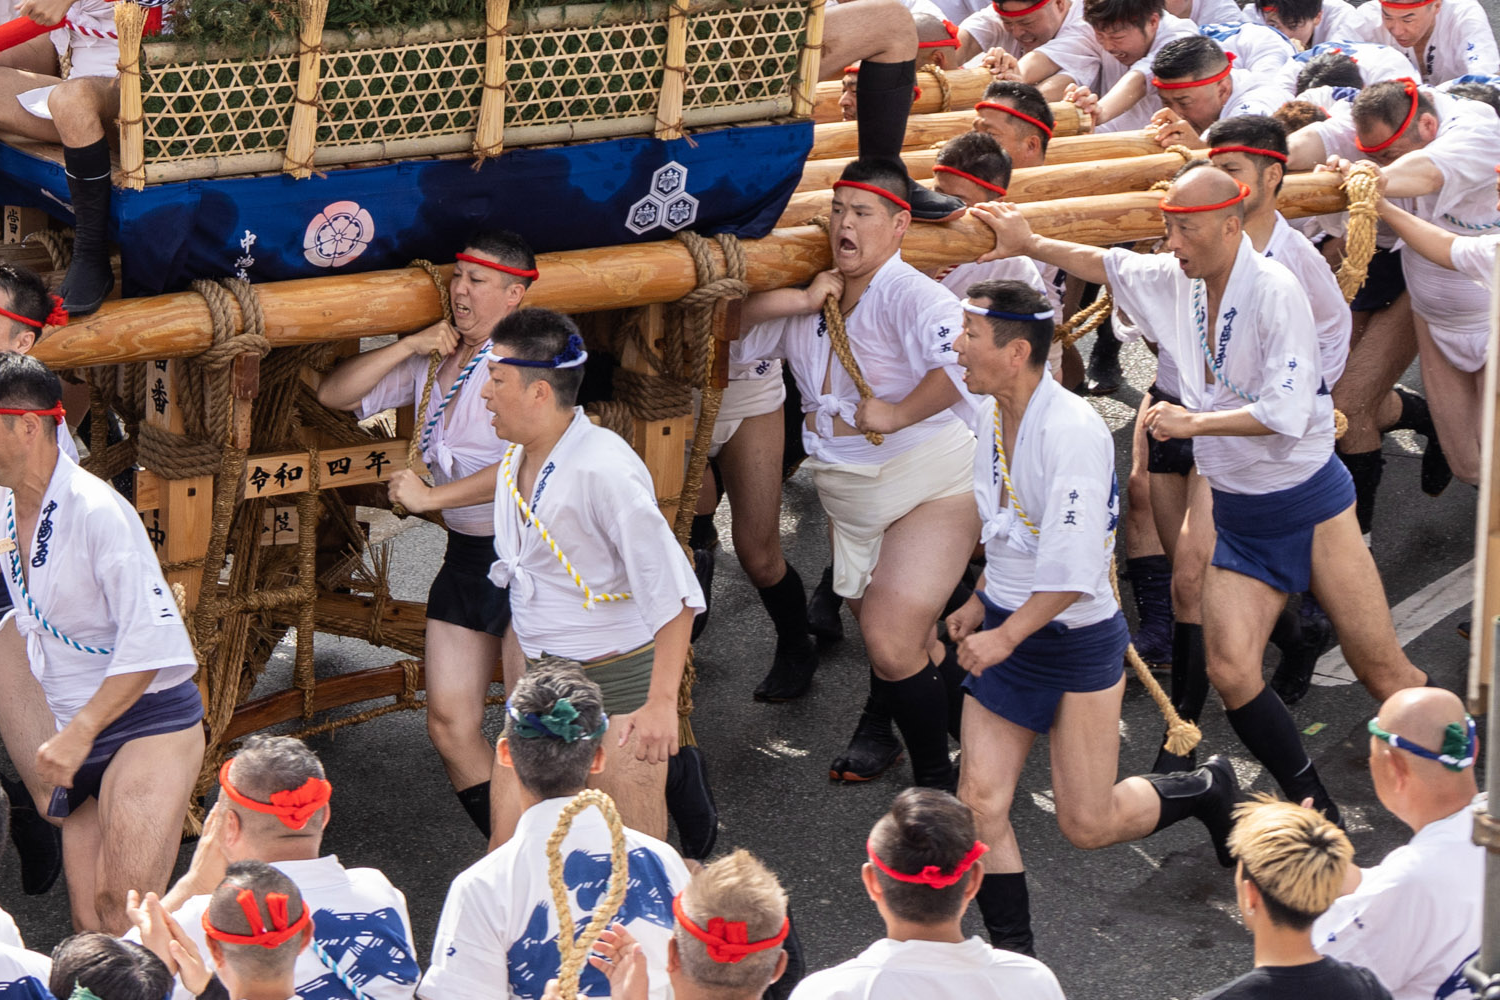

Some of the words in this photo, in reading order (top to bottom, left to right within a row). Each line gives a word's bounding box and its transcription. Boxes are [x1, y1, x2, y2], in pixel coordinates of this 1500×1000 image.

[248, 450, 391, 494] 令和四年
[1063, 489, 1080, 526] 中五
